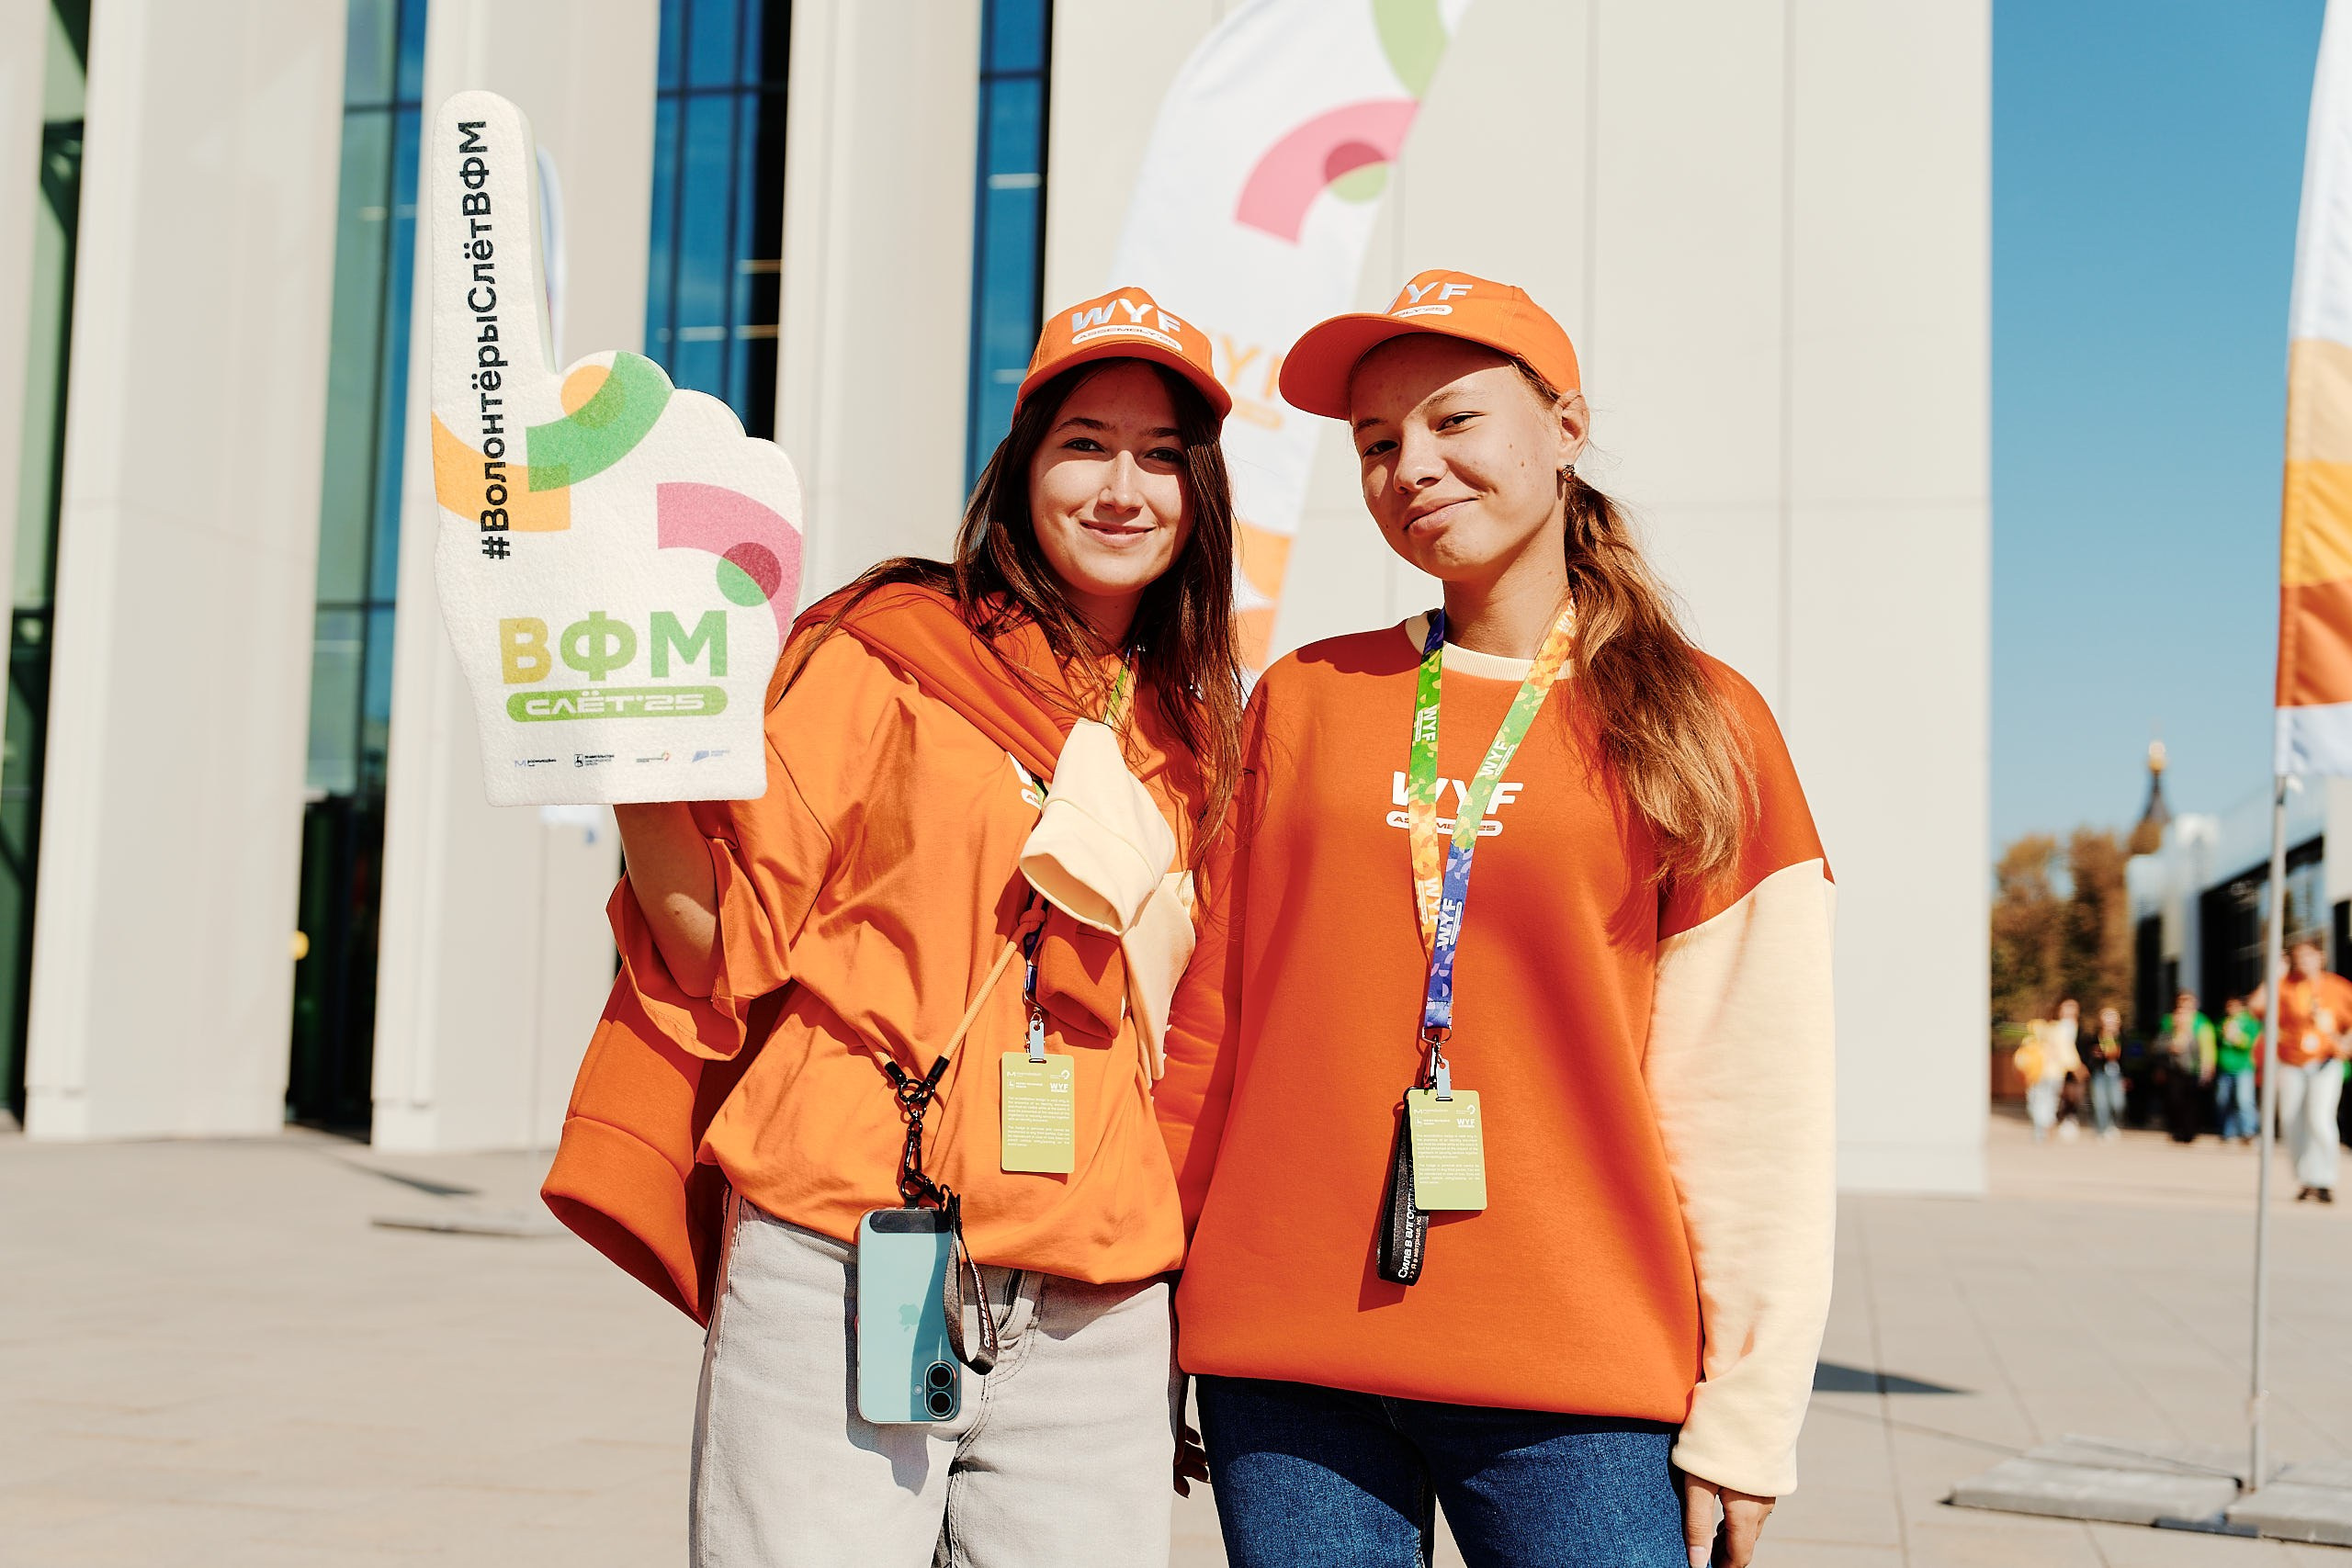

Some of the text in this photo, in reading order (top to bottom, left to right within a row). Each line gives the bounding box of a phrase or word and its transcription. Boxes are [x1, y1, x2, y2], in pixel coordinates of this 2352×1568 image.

[1072, 298, 1181, 333] WYF
[458, 120, 511, 560] #ВолонтёрыСлётВФМ
[499, 610, 728, 684] ВФМ
[1422, 704, 1440, 741] WYF
[1478, 739, 1508, 778] WYF
[1437, 897, 1455, 947] WYF
[1398, 1248, 1414, 1279] Сила
